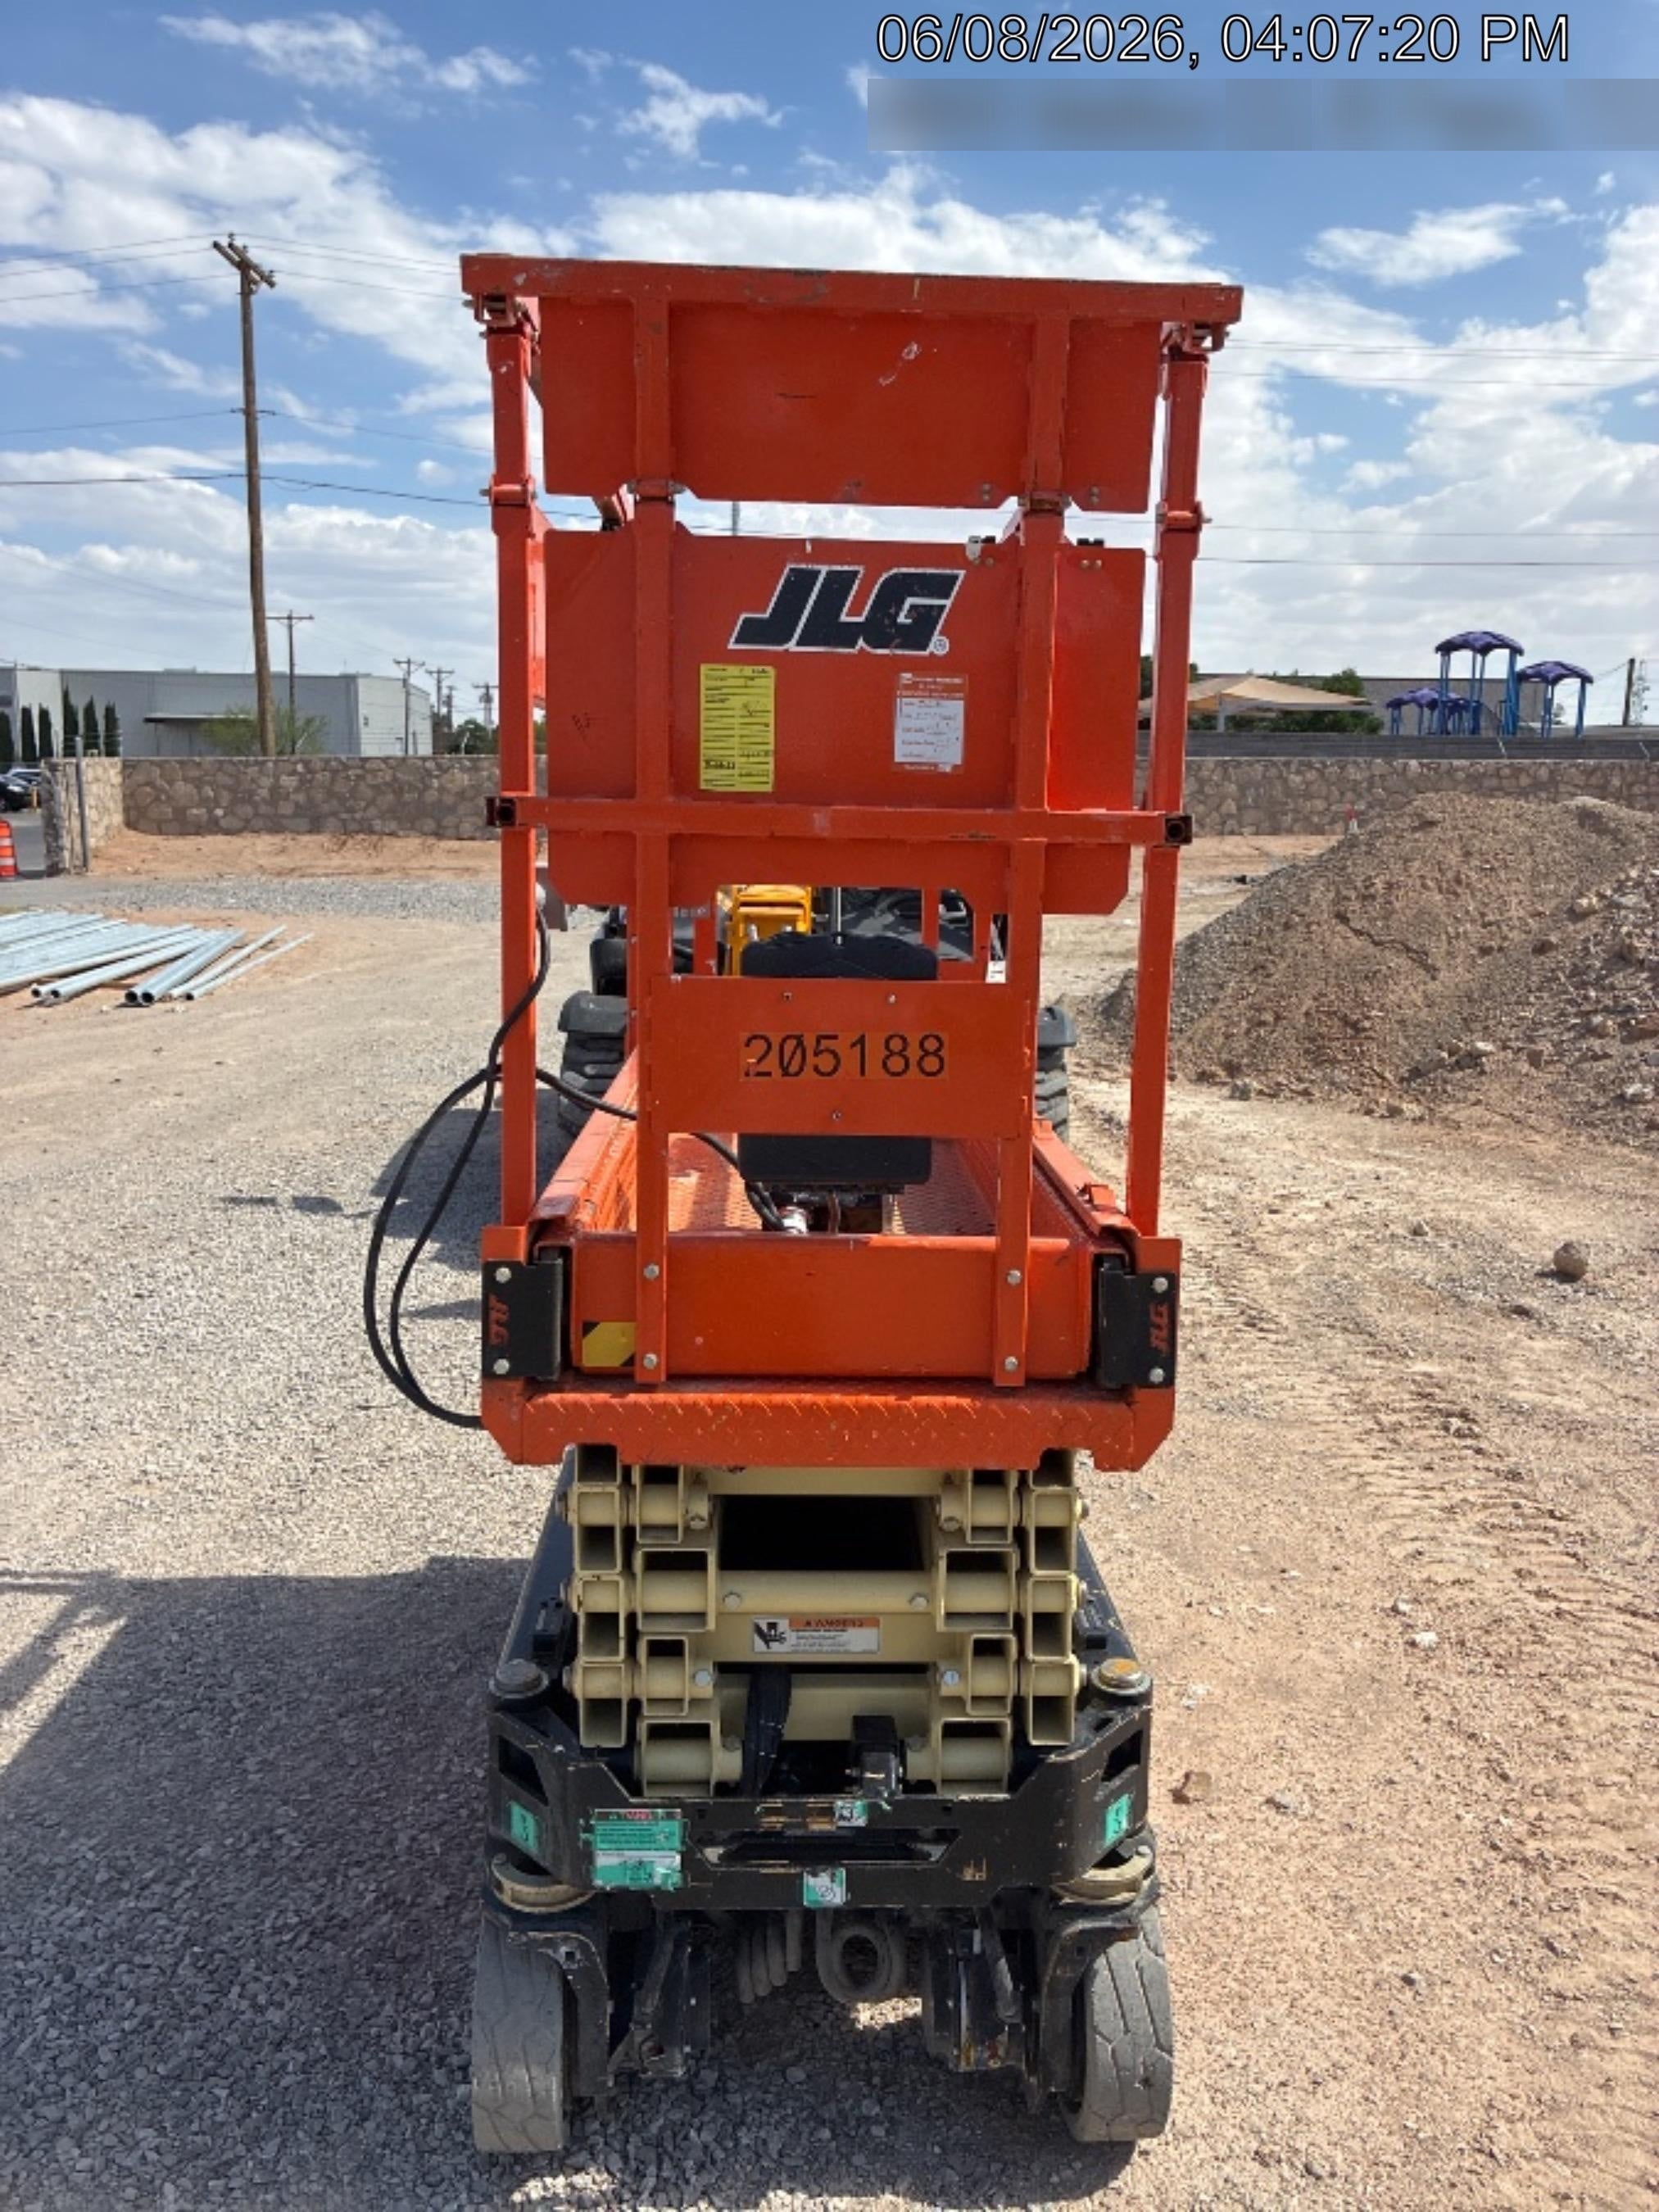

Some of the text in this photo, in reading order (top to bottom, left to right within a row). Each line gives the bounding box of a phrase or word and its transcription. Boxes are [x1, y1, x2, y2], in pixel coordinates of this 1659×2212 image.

[728, 564, 966, 655] JLG
[744, 1033, 945, 1077] 205188
[489, 1293, 510, 1345] JLG
